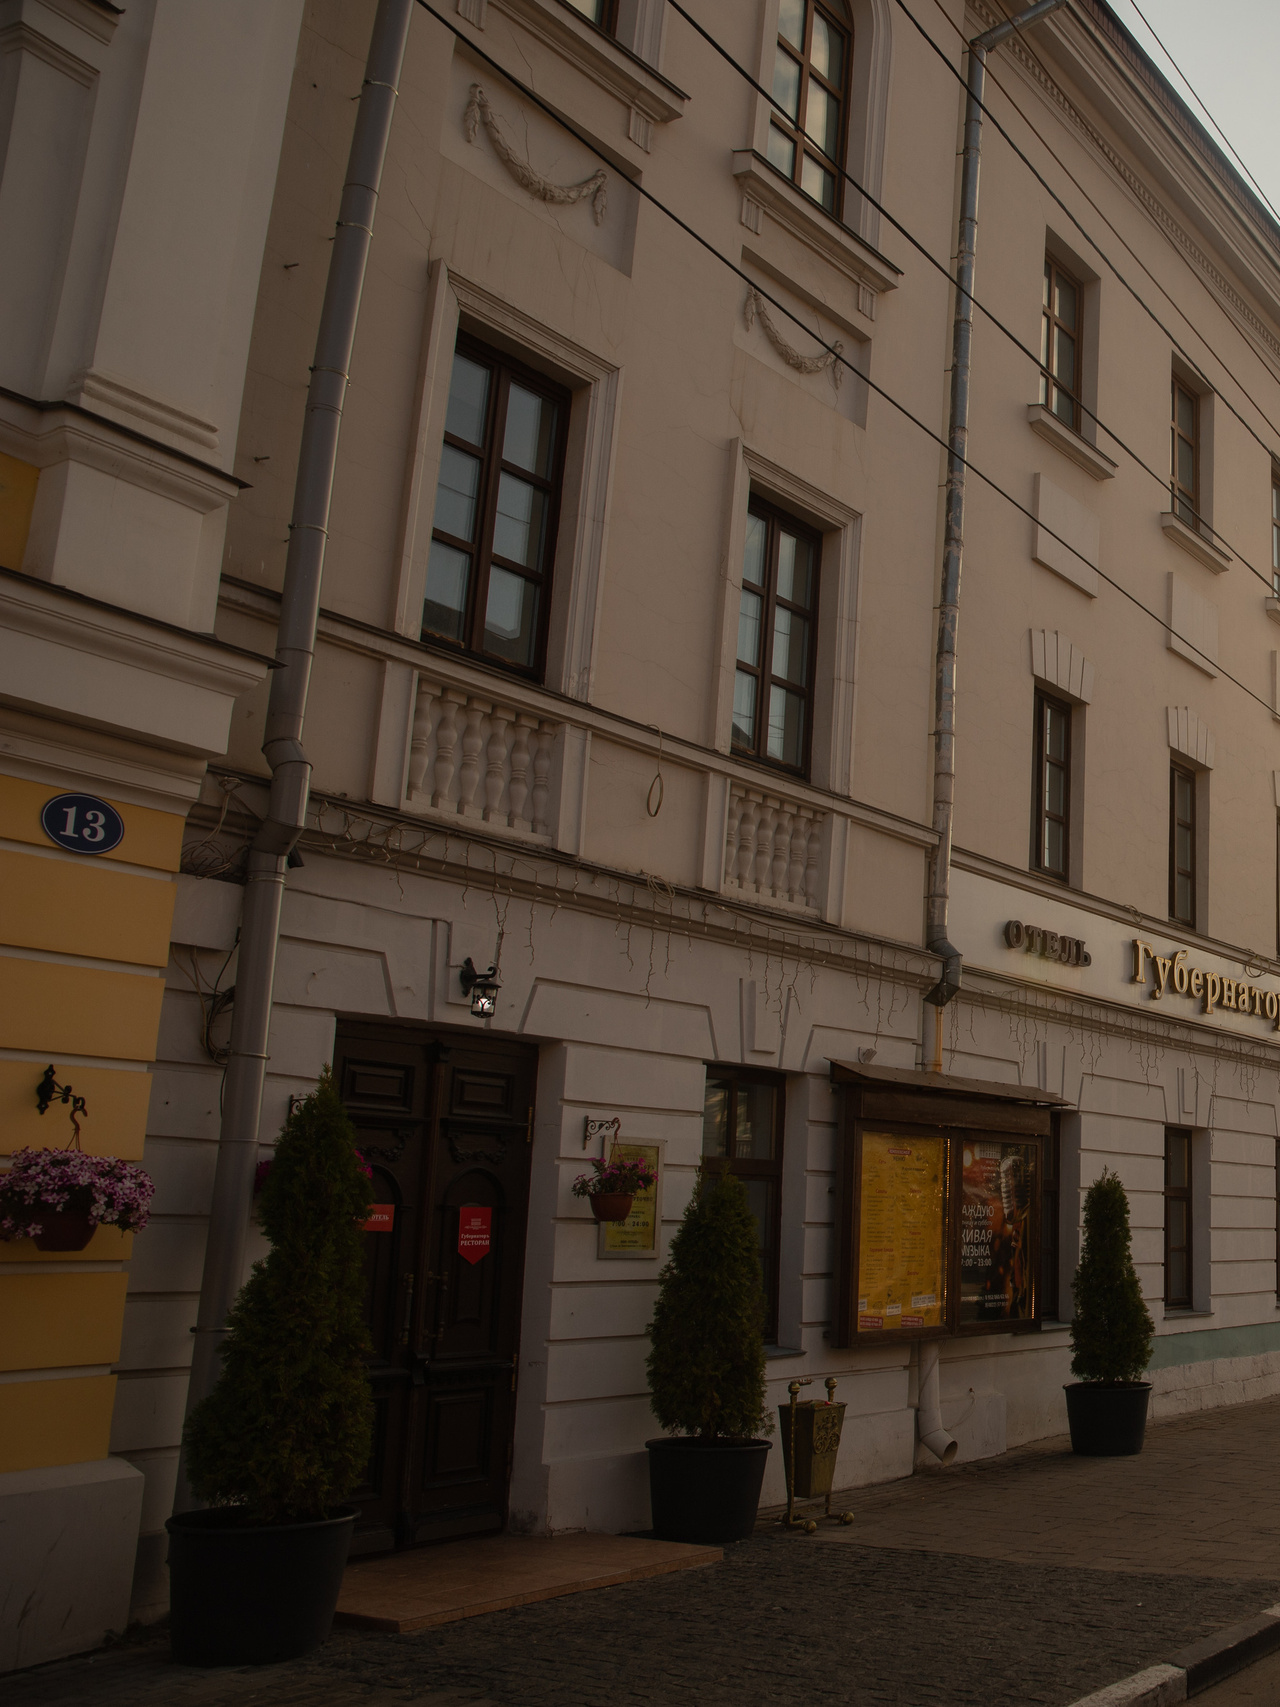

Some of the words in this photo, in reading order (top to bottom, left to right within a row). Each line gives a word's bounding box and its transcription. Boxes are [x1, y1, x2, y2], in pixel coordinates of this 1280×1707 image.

[60, 806, 106, 842] 13
[1004, 919, 1092, 968] ОТЕЛЬ
[962, 1204, 995, 1219] АЖДУЮ
